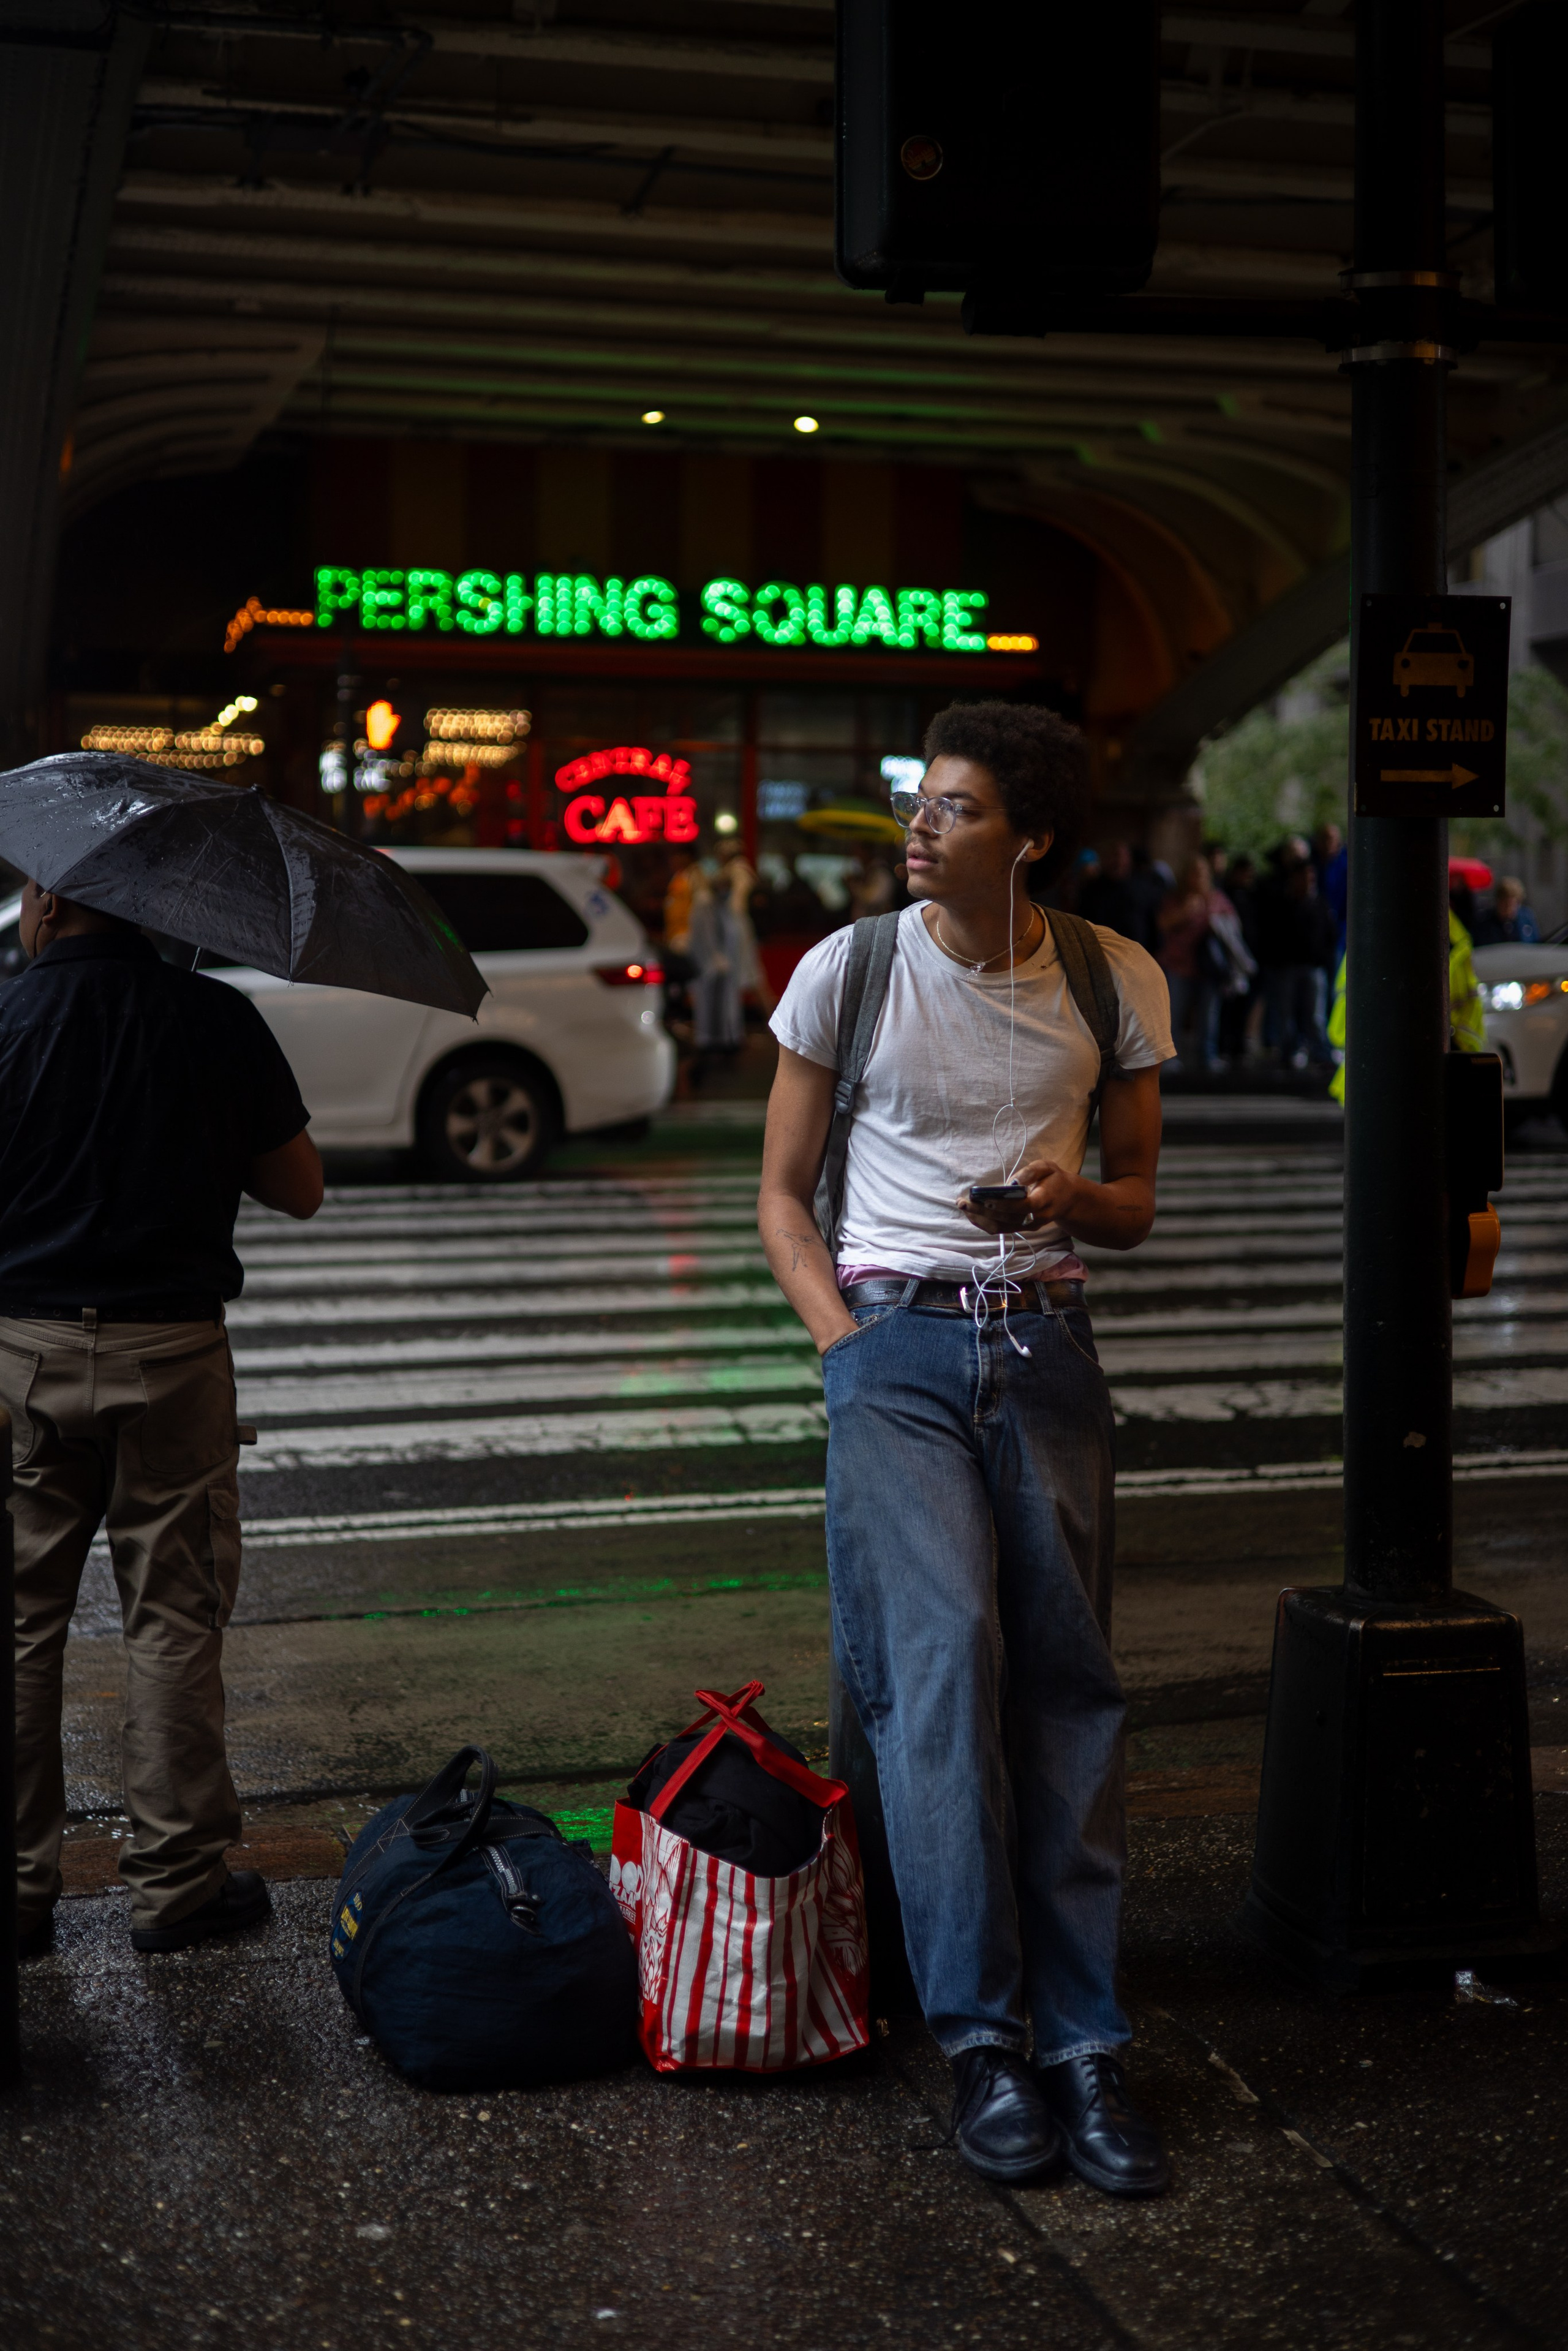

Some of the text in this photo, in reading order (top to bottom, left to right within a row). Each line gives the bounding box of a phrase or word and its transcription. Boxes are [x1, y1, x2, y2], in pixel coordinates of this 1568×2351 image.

[314, 565, 989, 653] PERSHING SQUARE
[1368, 717, 1495, 742] TAXI STAND
